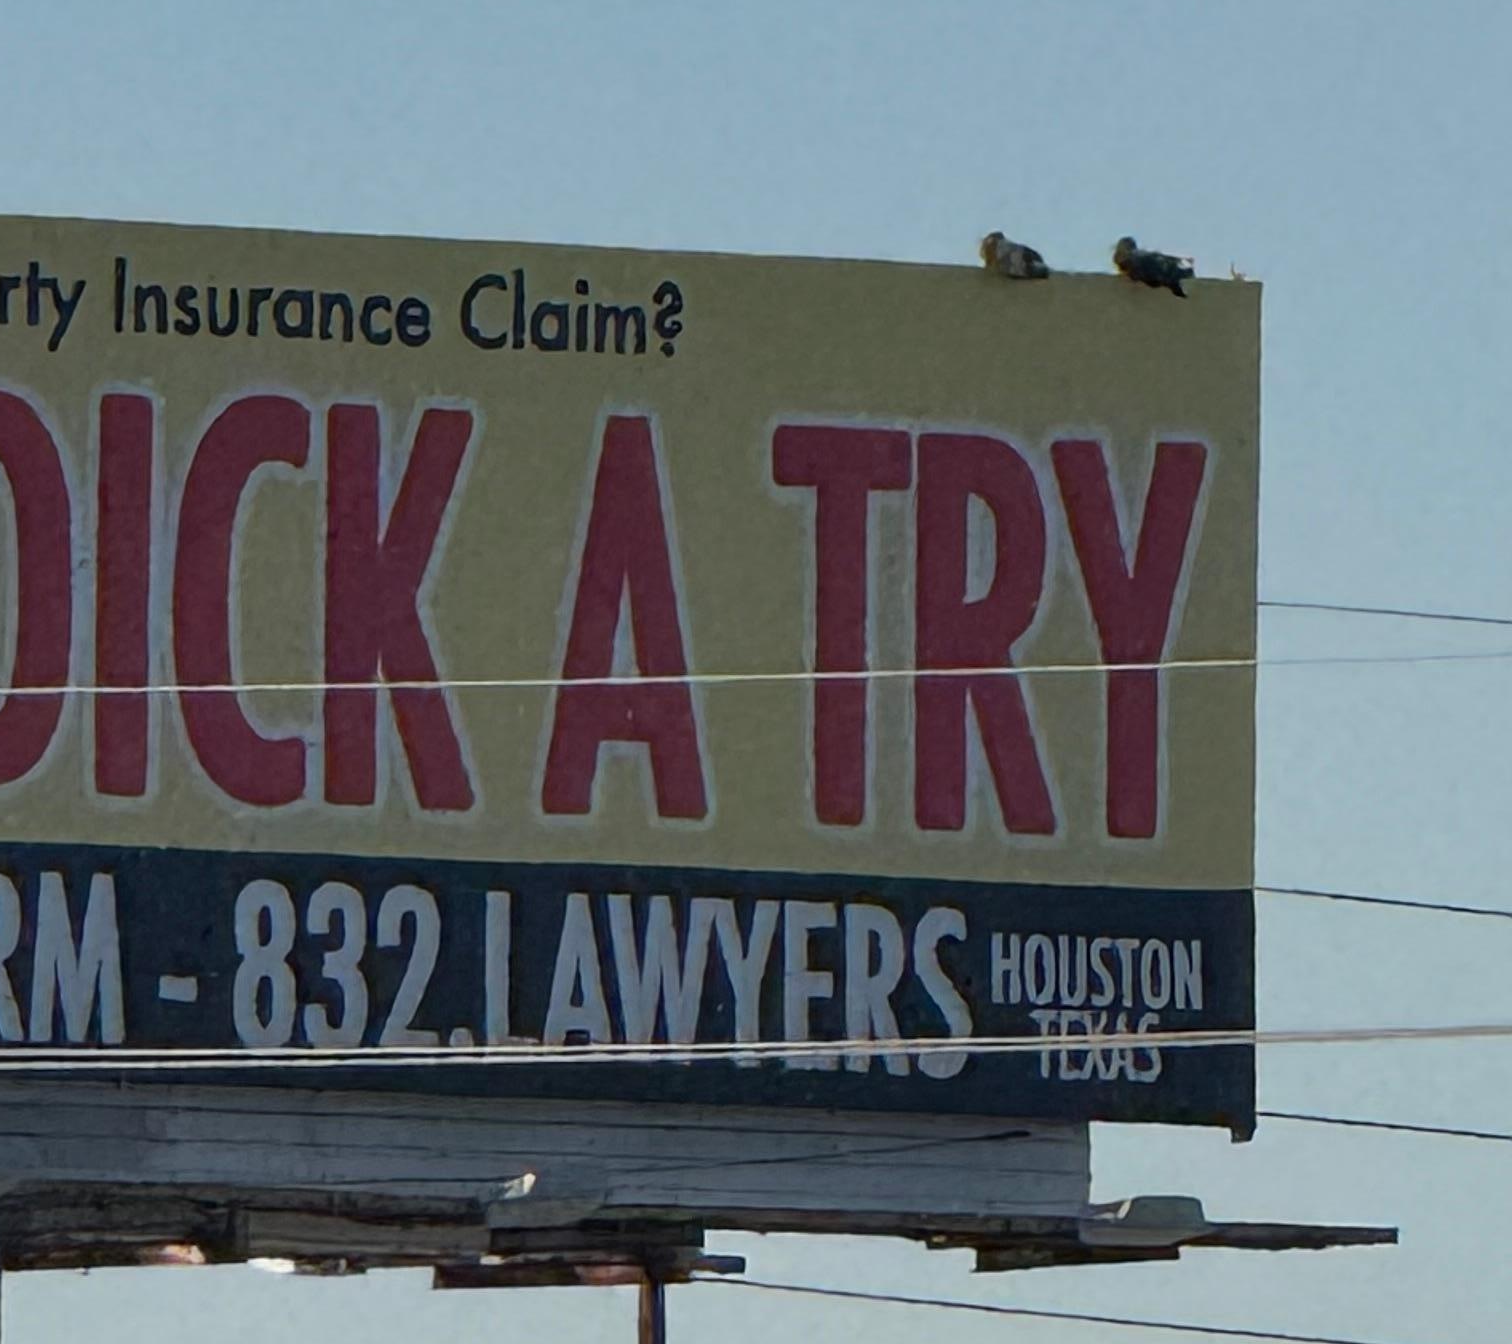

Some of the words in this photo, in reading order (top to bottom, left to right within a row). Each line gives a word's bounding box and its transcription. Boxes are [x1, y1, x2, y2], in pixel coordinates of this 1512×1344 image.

[114, 257, 431, 348] Insurance
[461, 269, 684, 358] Claim?
[541, 414, 709, 821] A
[771, 423, 1209, 840] TRY
[157, 975, 198, 1004] -
[232, 879, 974, 1080] 832.LAWYERS
[990, 932, 1204, 1010] HOUSTON
[1028, 1008, 1164, 1083] TEXAS
